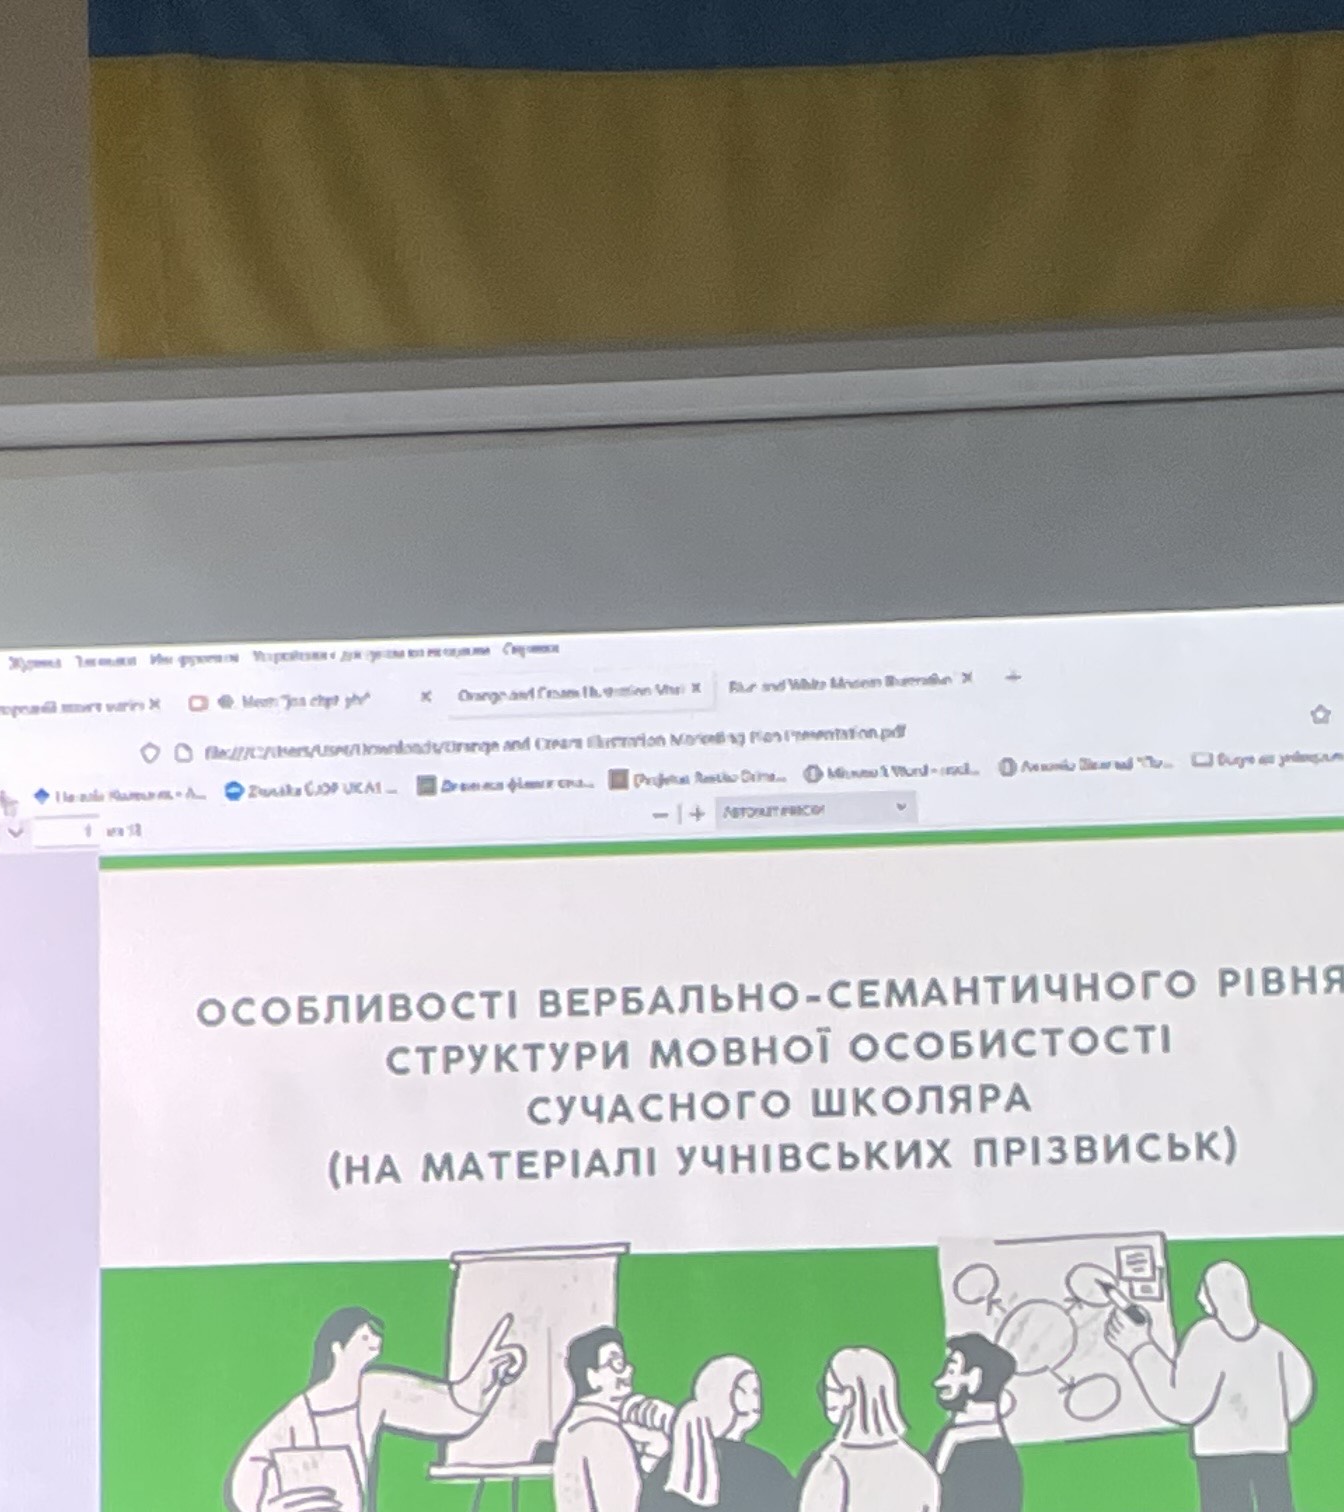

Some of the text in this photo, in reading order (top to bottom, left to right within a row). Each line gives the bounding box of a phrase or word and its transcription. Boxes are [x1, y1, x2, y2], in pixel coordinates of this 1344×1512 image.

[197, 990, 516, 1026] ОСОБЛИВОСТІ
[539, 970, 1196, 1018] ВЕРБАЛЬНО-СЕМАНТИЧНОГО
[386, 1024, 1170, 1075] СТРУКТУРИ МОВНОЇ ОСОБИСТОСТІ
[527, 1083, 1032, 1126] СУЧАСНОГО ШКОЛЯРА
[329, 1125, 1236, 1189] (НА МАТЕРІАЛІ УЧНІВСЬКИХ ПРІЗВИСЬК)
